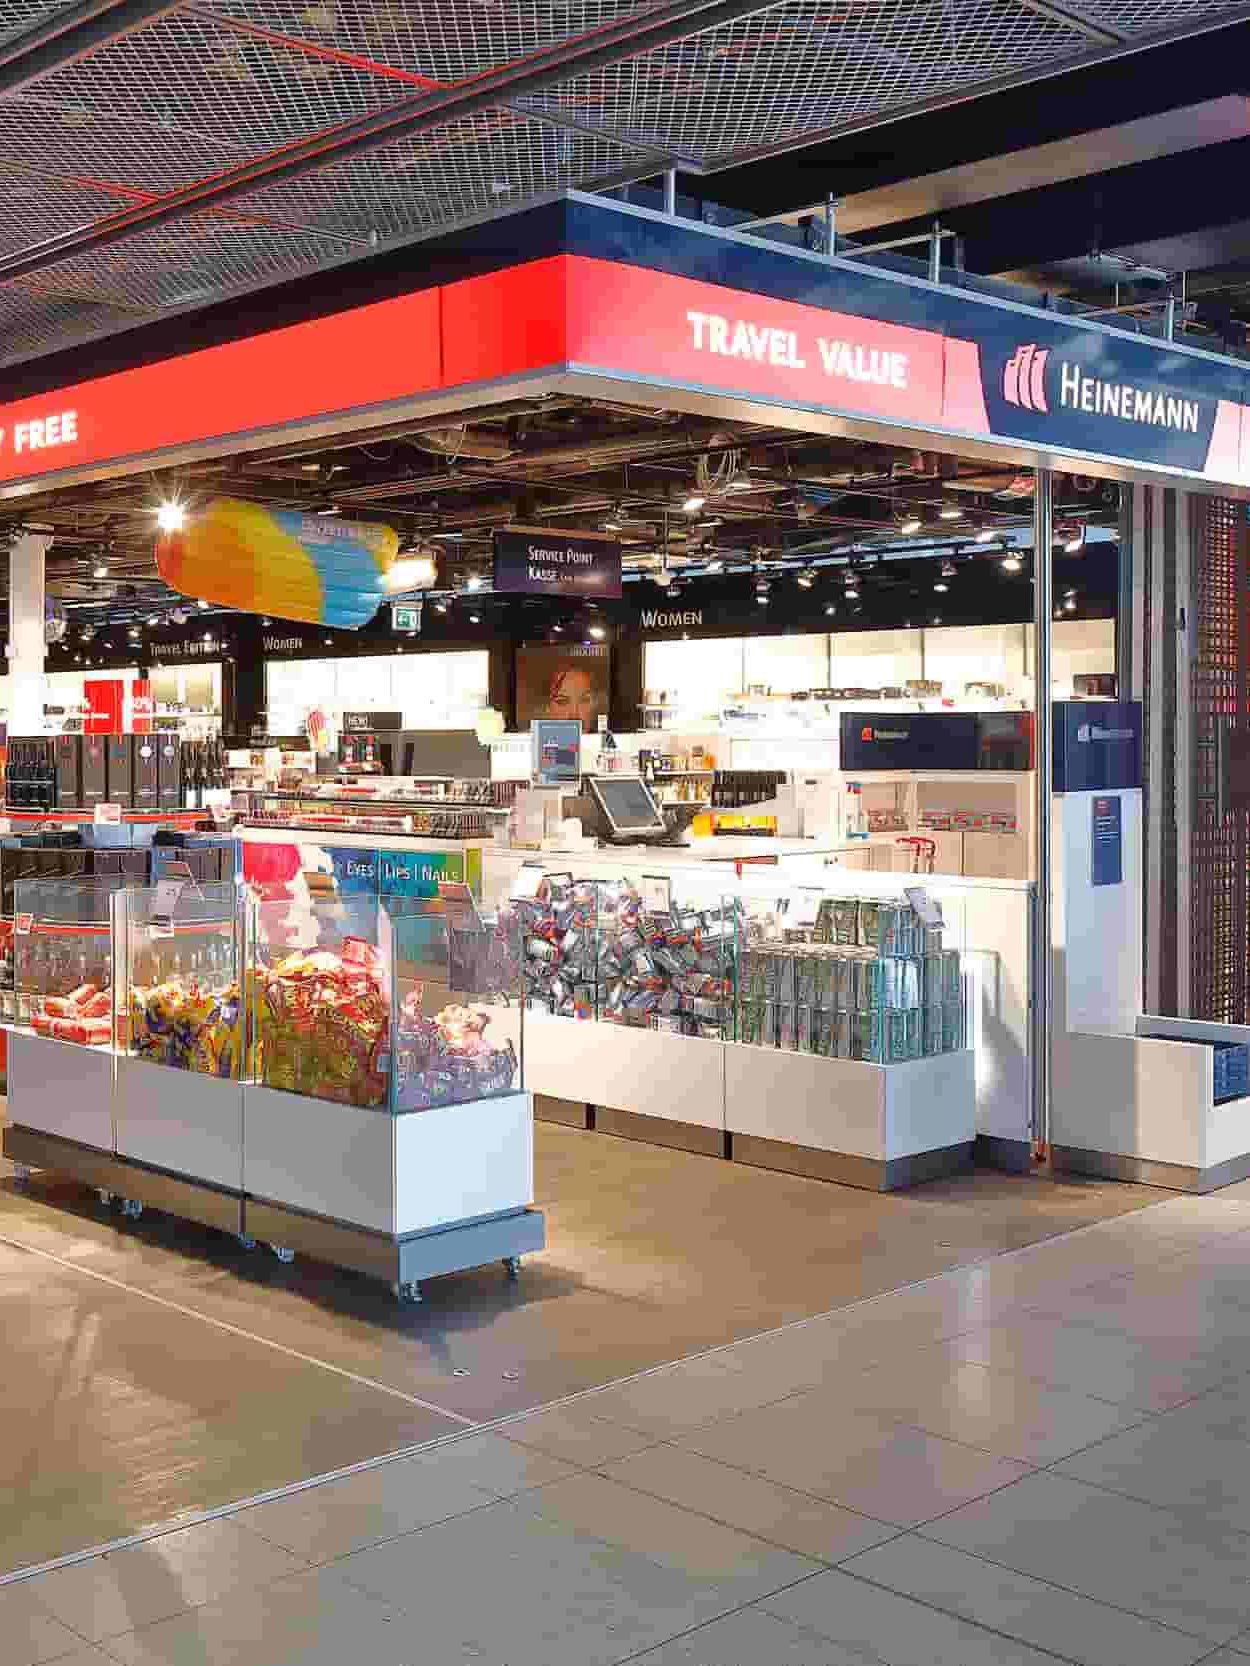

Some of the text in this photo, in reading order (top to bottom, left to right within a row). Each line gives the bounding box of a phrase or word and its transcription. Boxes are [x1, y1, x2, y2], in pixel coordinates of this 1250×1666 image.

[687, 311, 910, 389] TRAVEL VALUE
[13, 410, 79, 455] FREE
